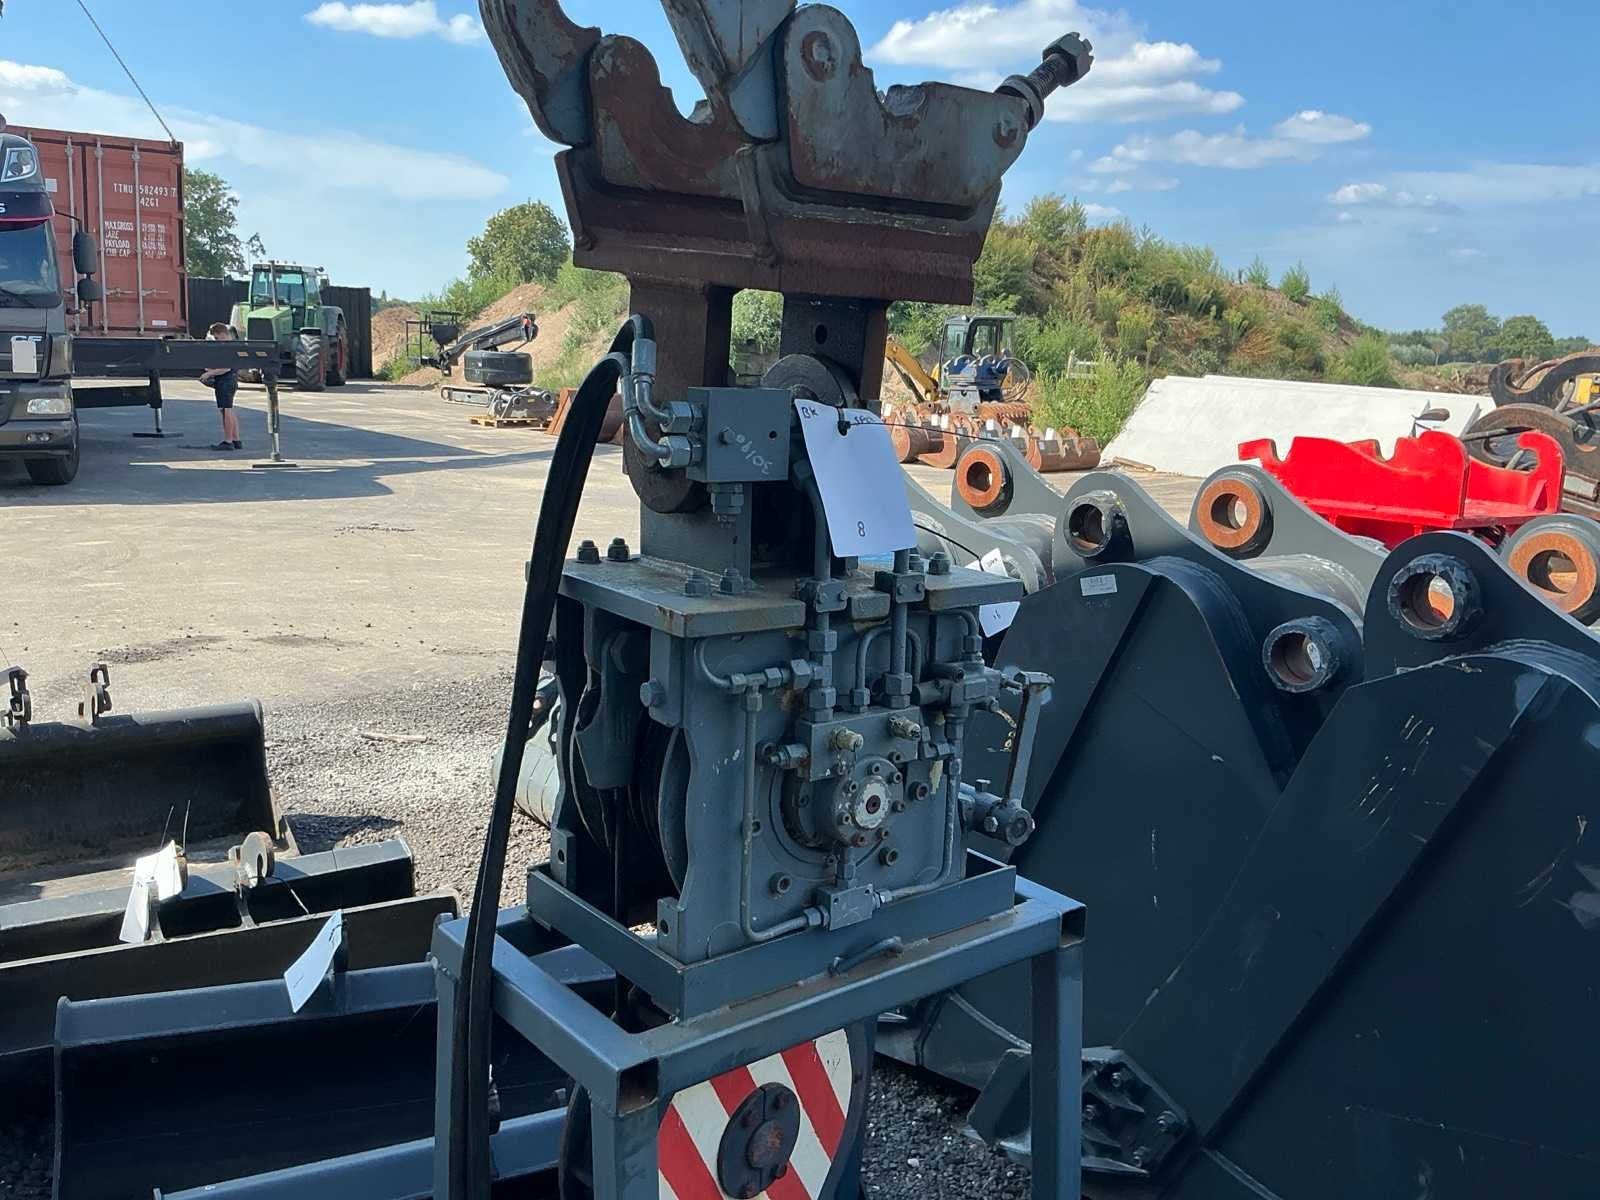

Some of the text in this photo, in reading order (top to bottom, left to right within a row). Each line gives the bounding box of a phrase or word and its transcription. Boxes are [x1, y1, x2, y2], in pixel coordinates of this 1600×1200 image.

[139, 184, 168, 197] 582493
[140, 196, 159, 207] 42G1
[104, 239, 130, 249] PAYLOAD
[857, 520, 866, 537] 8
